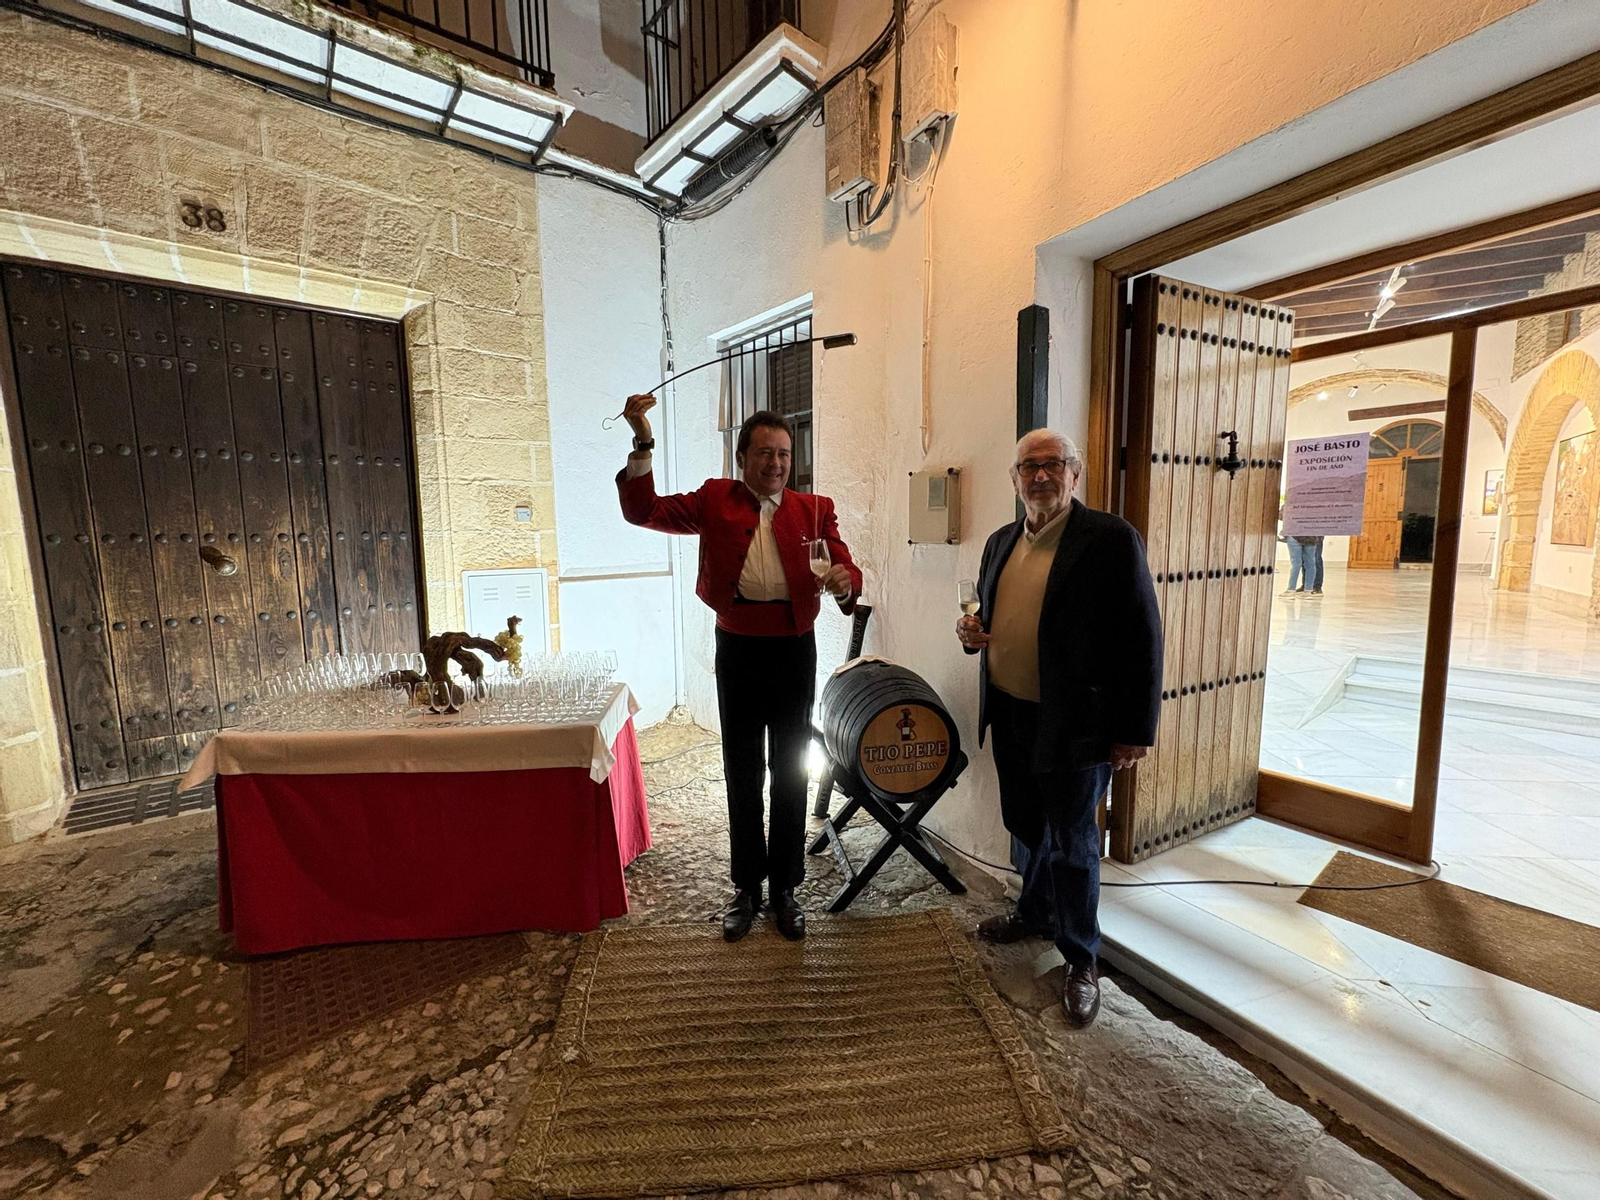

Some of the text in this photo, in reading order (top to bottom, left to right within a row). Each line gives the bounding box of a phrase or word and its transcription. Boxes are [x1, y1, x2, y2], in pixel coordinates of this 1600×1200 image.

[179, 196, 227, 233] 38
[1294, 440, 1360, 453] JOSÉ BASTO
[1299, 454, 1353, 465] EXPOSICIÓN
[865, 741, 947, 761] TIO PEPE
